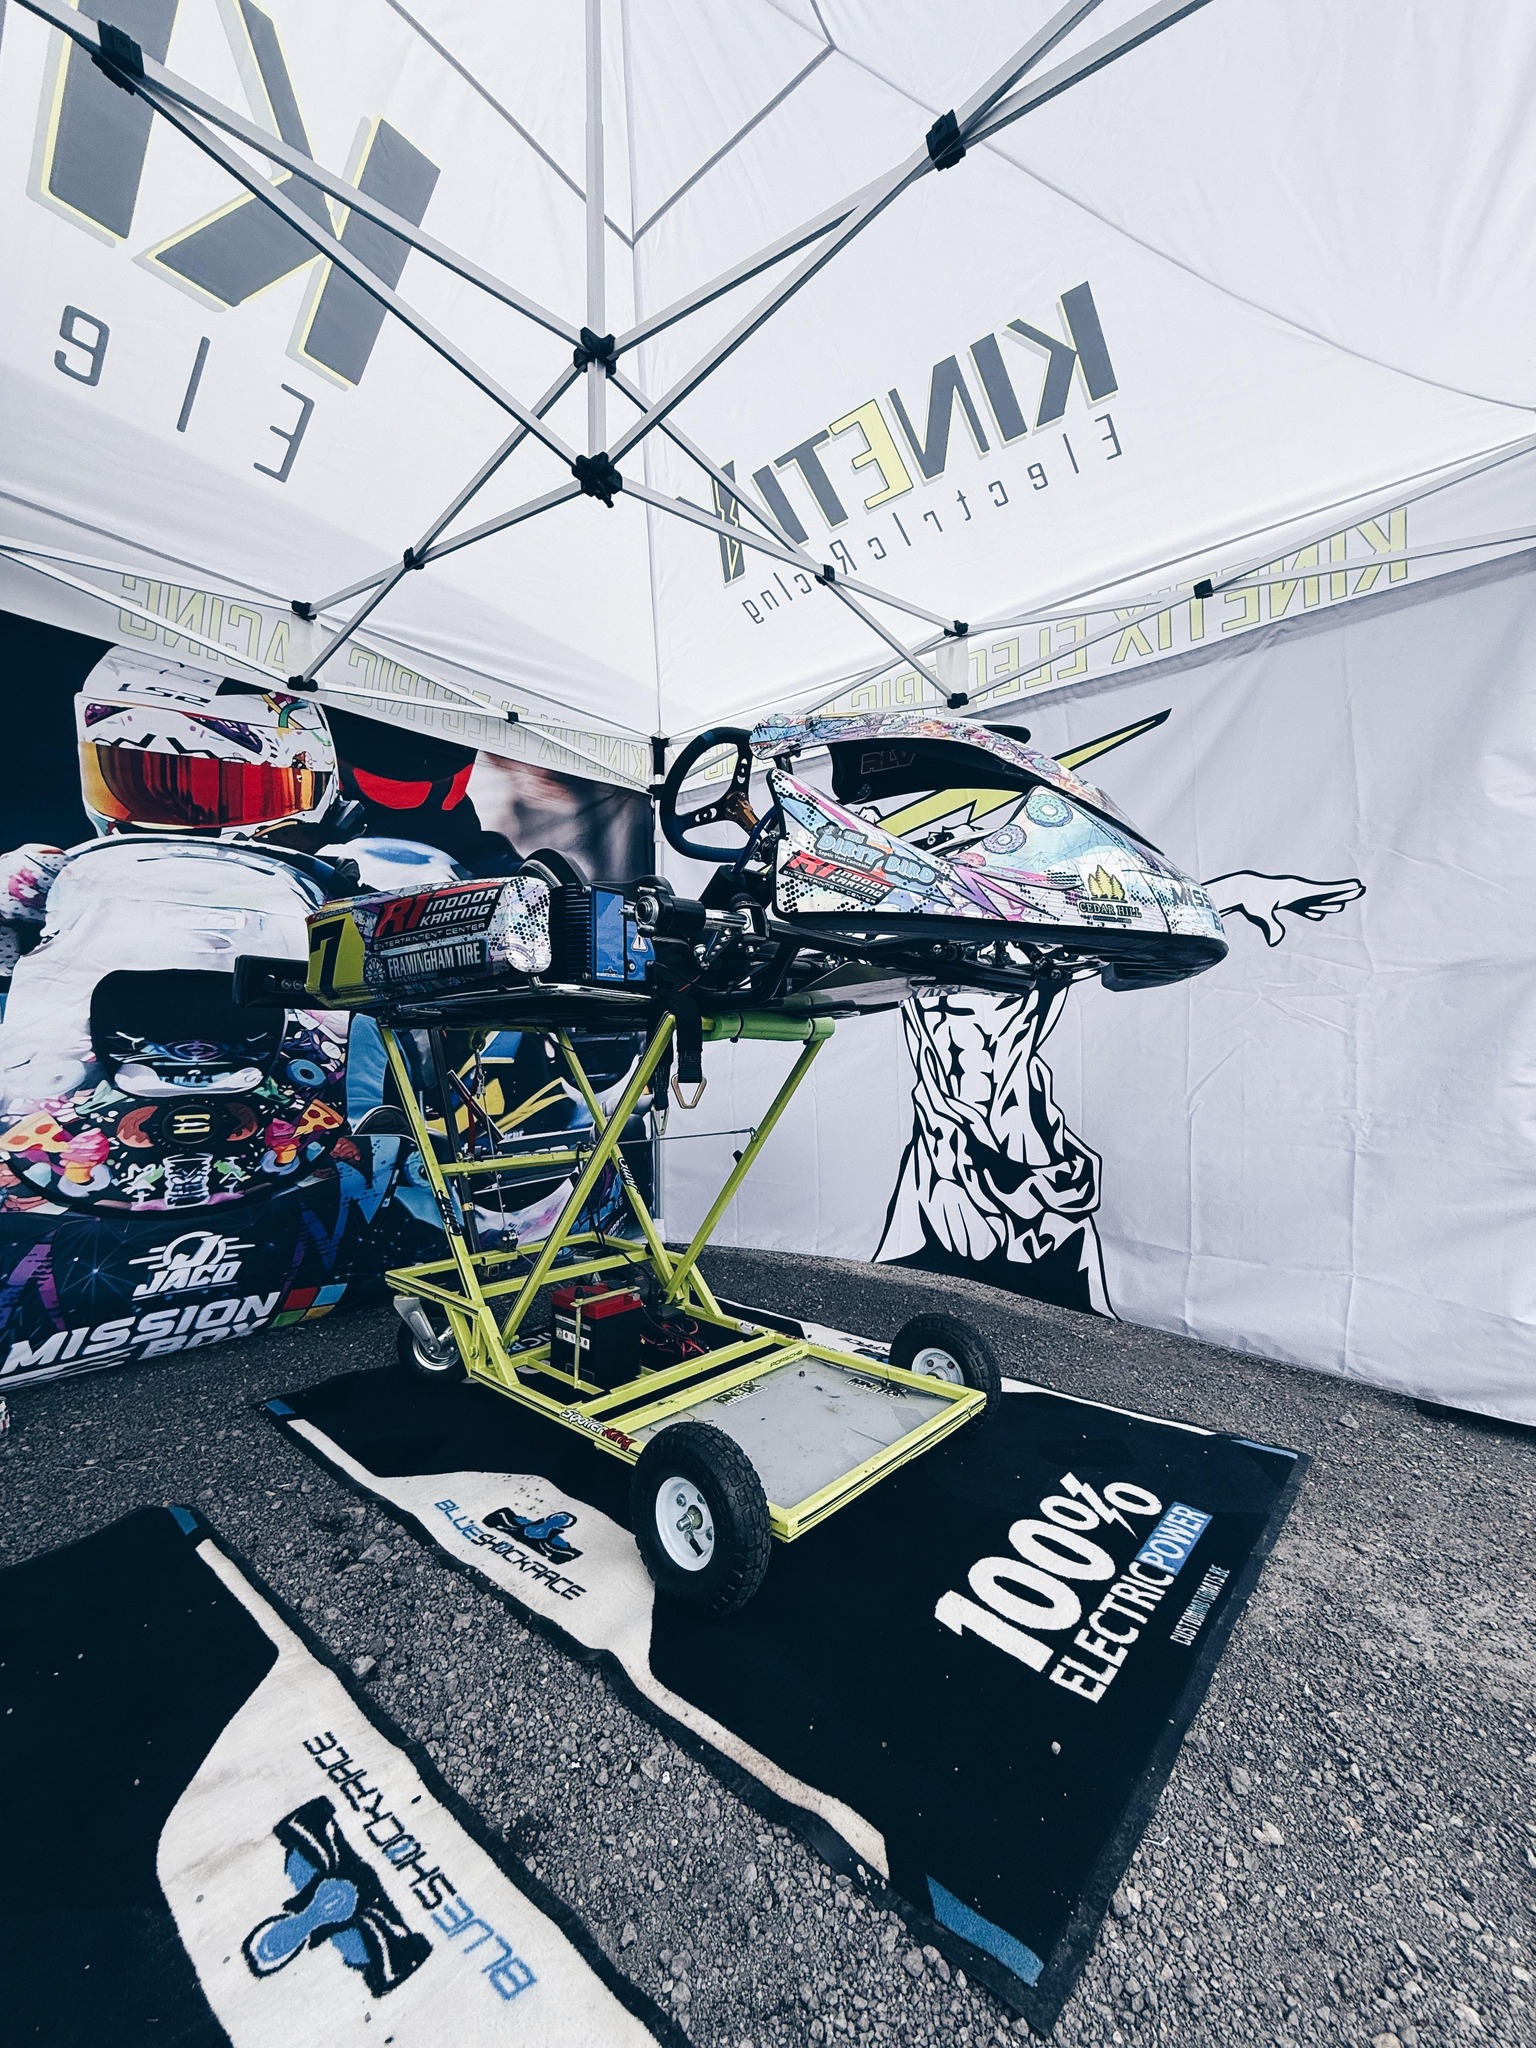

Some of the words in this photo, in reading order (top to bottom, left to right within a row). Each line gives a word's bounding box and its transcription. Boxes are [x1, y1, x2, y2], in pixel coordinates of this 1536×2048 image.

[816, 832, 884, 866] DIRTY
[884, 854, 936, 885] BIRD
[827, 874, 884, 898] KARTING
[834, 869, 892, 893] INDOOR
[427, 889, 499, 913] INDOOR
[846, 891, 877, 905] CENTER
[1078, 901, 1116, 916] CEDAR
[1116, 905, 1142, 919] HILL
[419, 903, 491, 927] KARTING
[373, 930, 443, 951] ENTERTAINMENT
[445, 922, 486, 936] CENTER
[387, 946, 455, 979] FRAMINGHAM
[455, 942, 482, 967] TIRE
[132, 1261, 242, 1298] JACO
[0, 1291, 281, 1375] MISSION
[934, 1471, 1162, 1673] 100%
[1049, 1561, 1175, 1704] ELECTRIC
[1140, 1504, 1212, 1573] POWER
